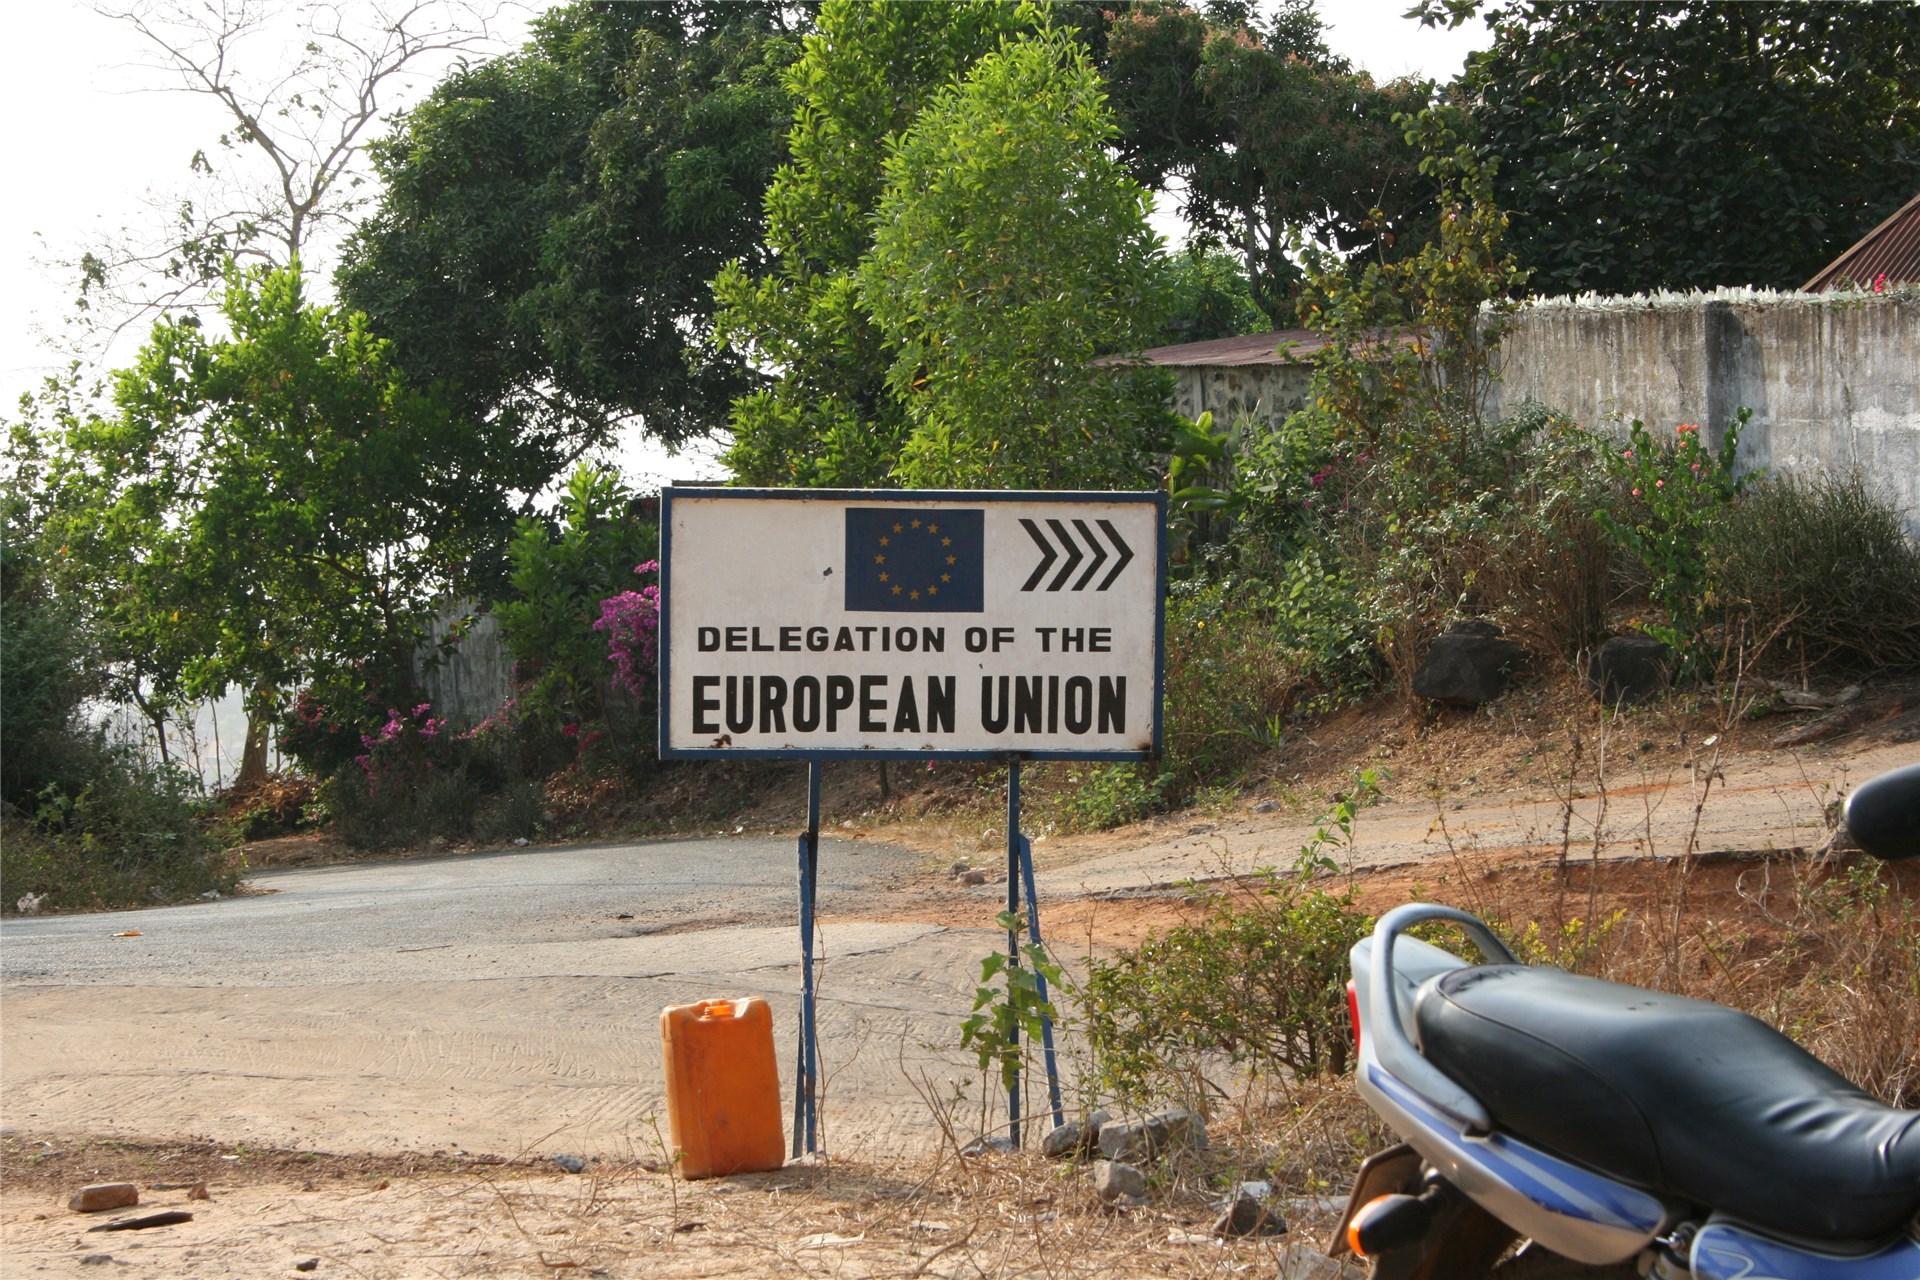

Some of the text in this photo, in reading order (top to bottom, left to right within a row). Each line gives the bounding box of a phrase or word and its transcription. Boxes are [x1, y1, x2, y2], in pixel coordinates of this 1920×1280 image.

[697, 626, 1112, 653] DELEGATION OF THE
[692, 674, 1127, 735] EUROPEAN UNION
